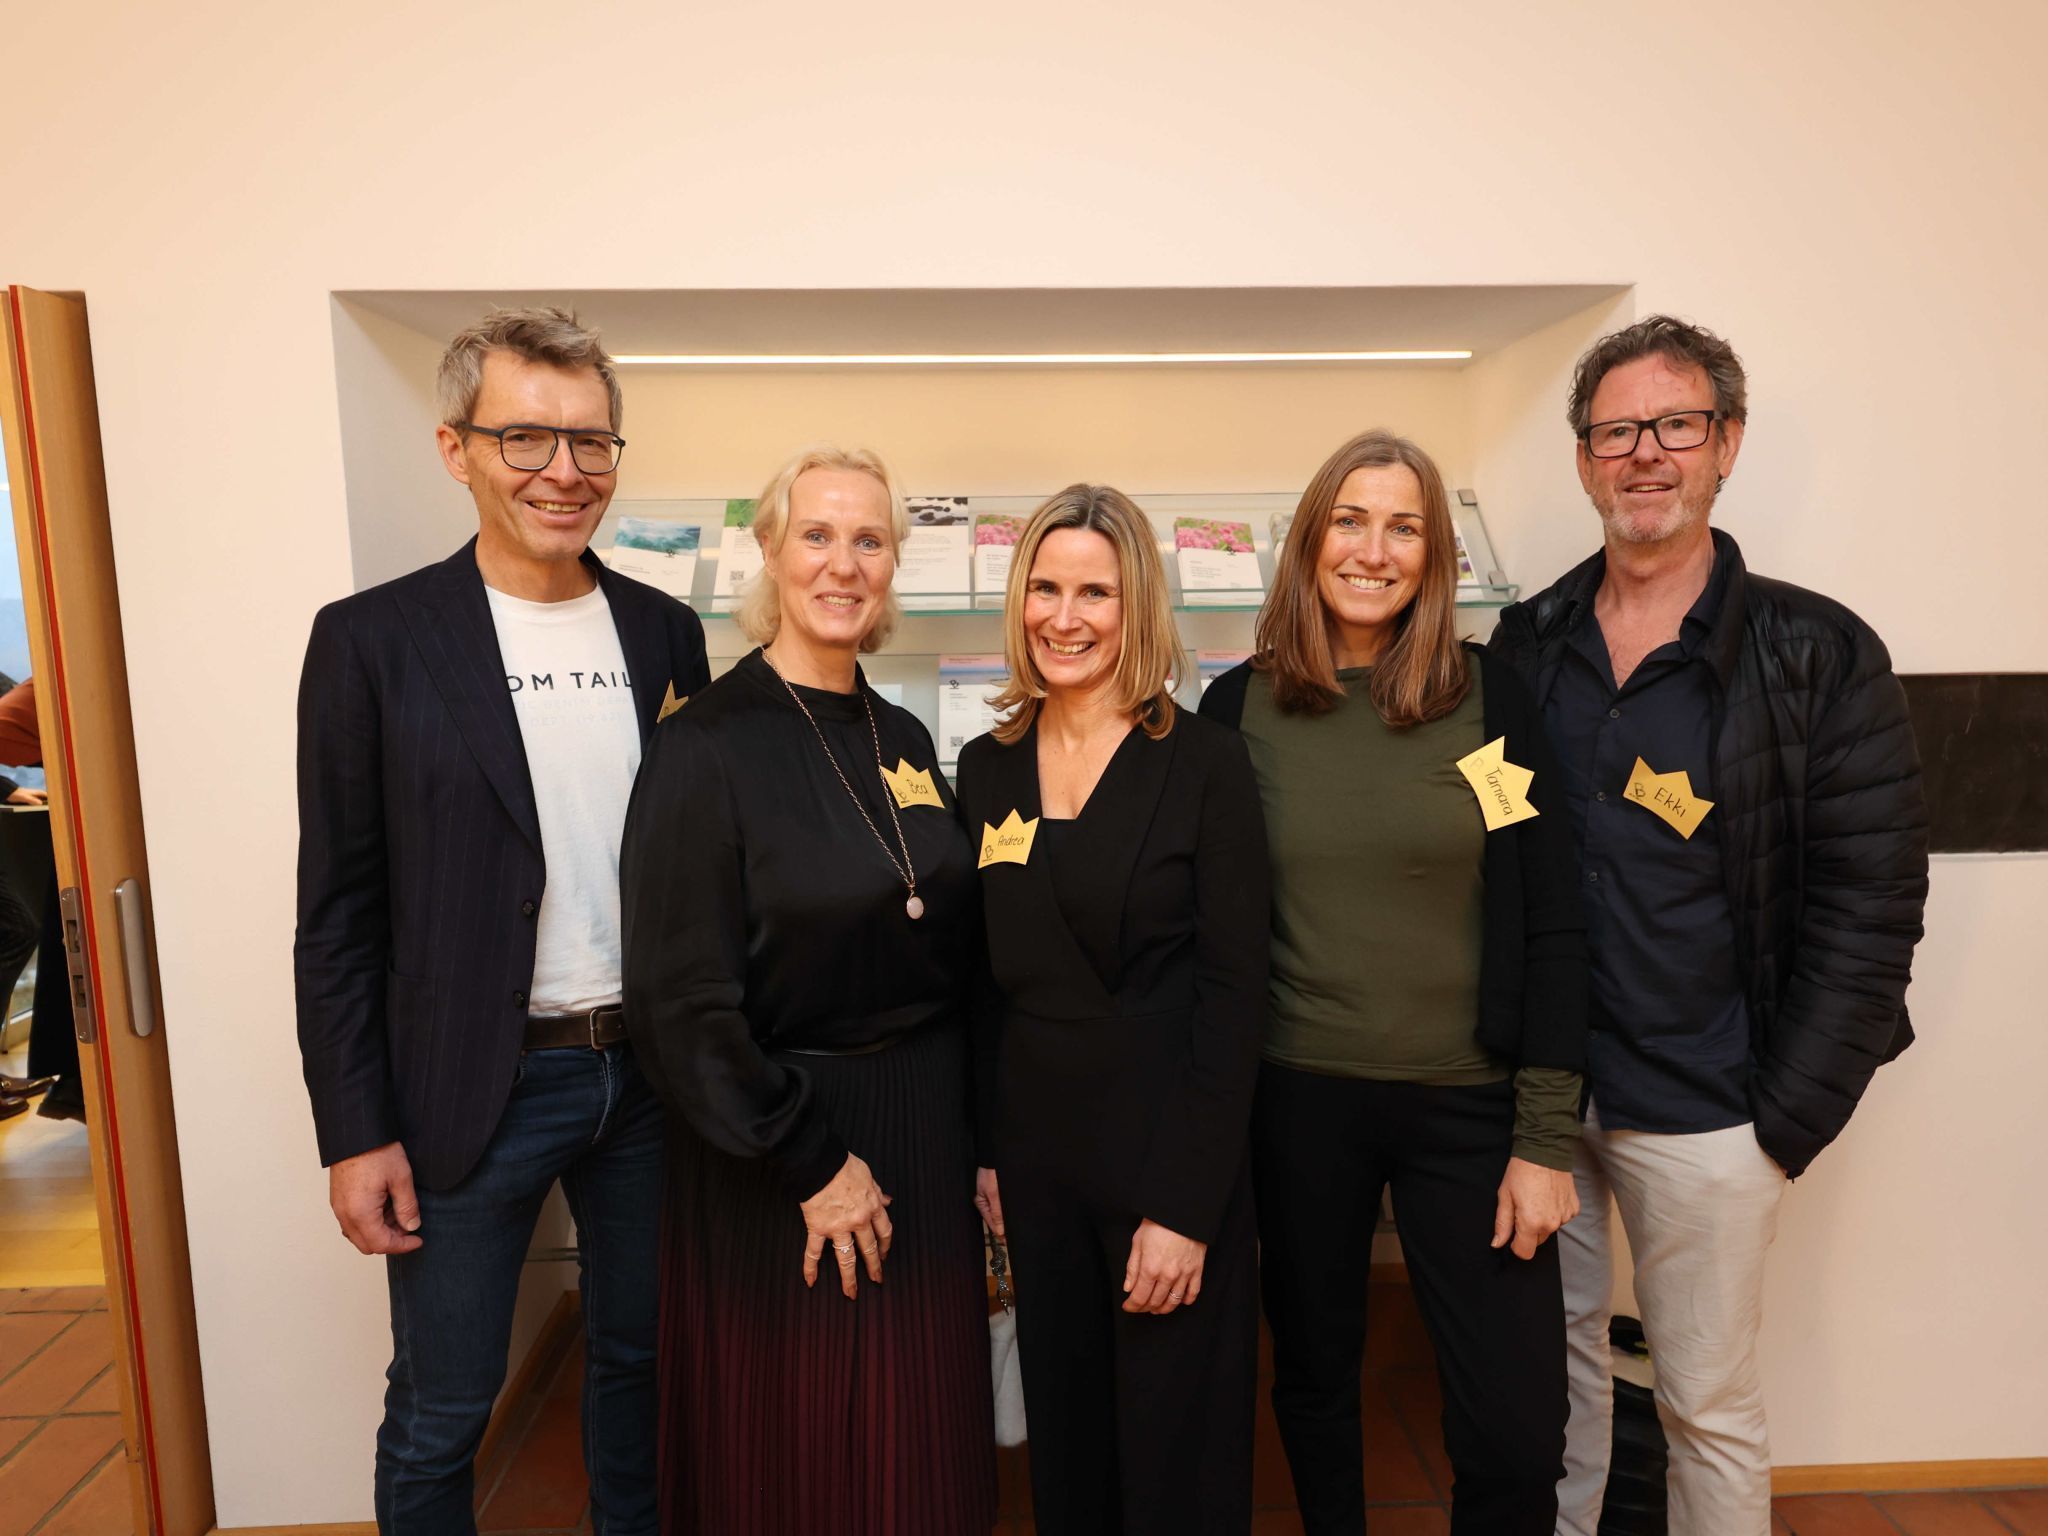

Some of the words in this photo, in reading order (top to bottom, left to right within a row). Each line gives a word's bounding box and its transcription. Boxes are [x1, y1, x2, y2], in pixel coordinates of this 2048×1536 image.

[905, 778, 929, 795] Bea
[1485, 766, 1513, 816] Tamara
[1654, 786, 1690, 818] Ekki
[997, 834, 1025, 847] Andrea
